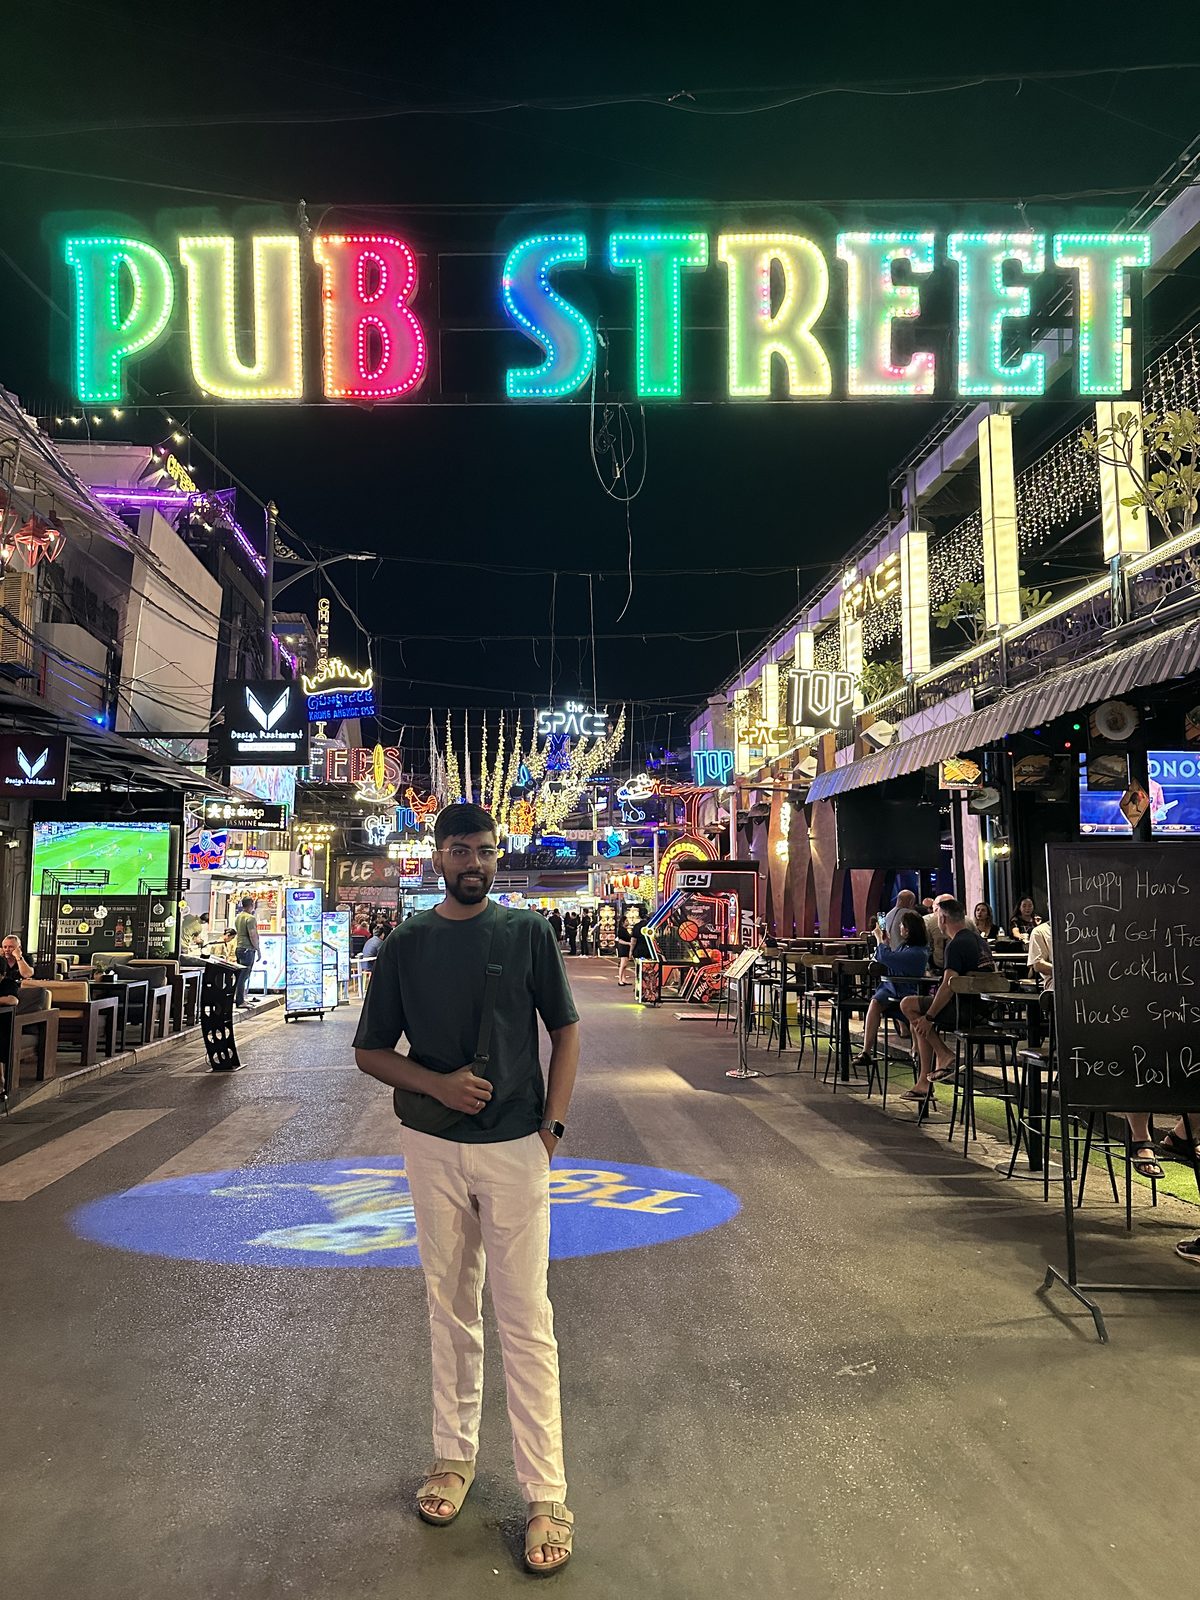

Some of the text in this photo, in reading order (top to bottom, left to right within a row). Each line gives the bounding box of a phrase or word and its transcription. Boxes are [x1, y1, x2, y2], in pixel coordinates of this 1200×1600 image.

[65, 230, 1151, 402] PUB STREET
[843, 552, 899, 622] SPACE
[566, 701, 584, 713] the
[788, 668, 855, 728] TOP
[230, 730, 258, 742] Design
[259, 729, 304, 739] Restaurant
[538, 712, 609, 735] SPACE
[738, 727, 789, 744] SPACE
[693, 750, 734, 787] TOP
[5, 777, 56, 787] Design Restaurant
[507, 834, 532, 854] TOP
[188, 850, 222, 870] Tiger
[338, 859, 387, 882] FLEX
[1066, 864, 1190, 916] Happy Hours
[1064, 912, 1102, 958] Buy
[1106, 923, 1118, 944] 1
[1124, 917, 1157, 942] Get
[1072, 958, 1096, 988] All
[1074, 999, 1131, 1025] House
[1069, 1045, 1171, 1088] Free Pool
